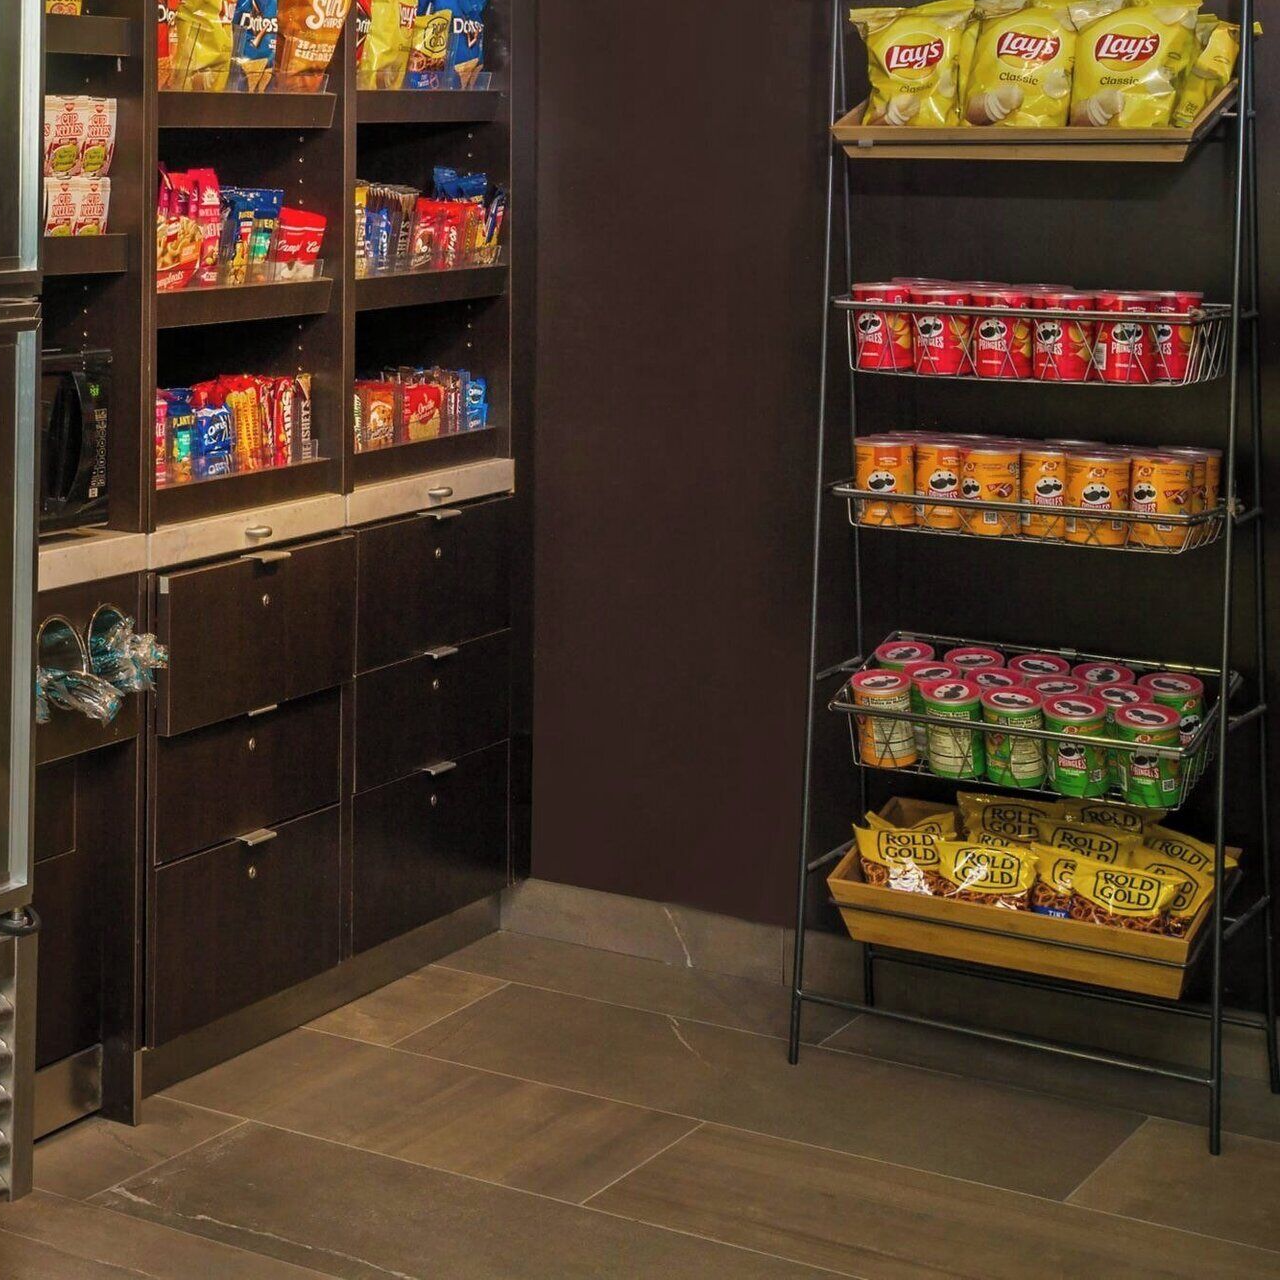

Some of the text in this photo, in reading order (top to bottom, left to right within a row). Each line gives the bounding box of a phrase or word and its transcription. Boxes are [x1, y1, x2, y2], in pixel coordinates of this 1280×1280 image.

[999, 32, 1058, 61] Lay's
[1097, 34, 1157, 62] Lay's
[890, 41, 941, 70] Lay's
[999, 71, 1040, 86] Classic
[1099, 76, 1140, 86] Classic
[61, 113, 79, 125] CUP
[55, 123, 84, 138] NOODLES
[858, 332, 883, 345] PRINGLES
[917, 337, 945, 349] PRINGLES
[978, 339, 1007, 352] PRINGLES
[1111, 341, 1143, 356] PRINGLES
[1057, 757, 1087, 770] PRINGLES
[1086, 810, 1136, 827] ROLD
[886, 833, 936, 846] ROLD
[1060, 830, 1113, 852] ROLD
[885, 846, 937, 861] GOLD
[1159, 840, 1202, 865] ROLD
[964, 851, 1015, 870] ROLD
[1103, 872, 1155, 892] ROLD
[1100, 885, 1151, 906] GOLD
